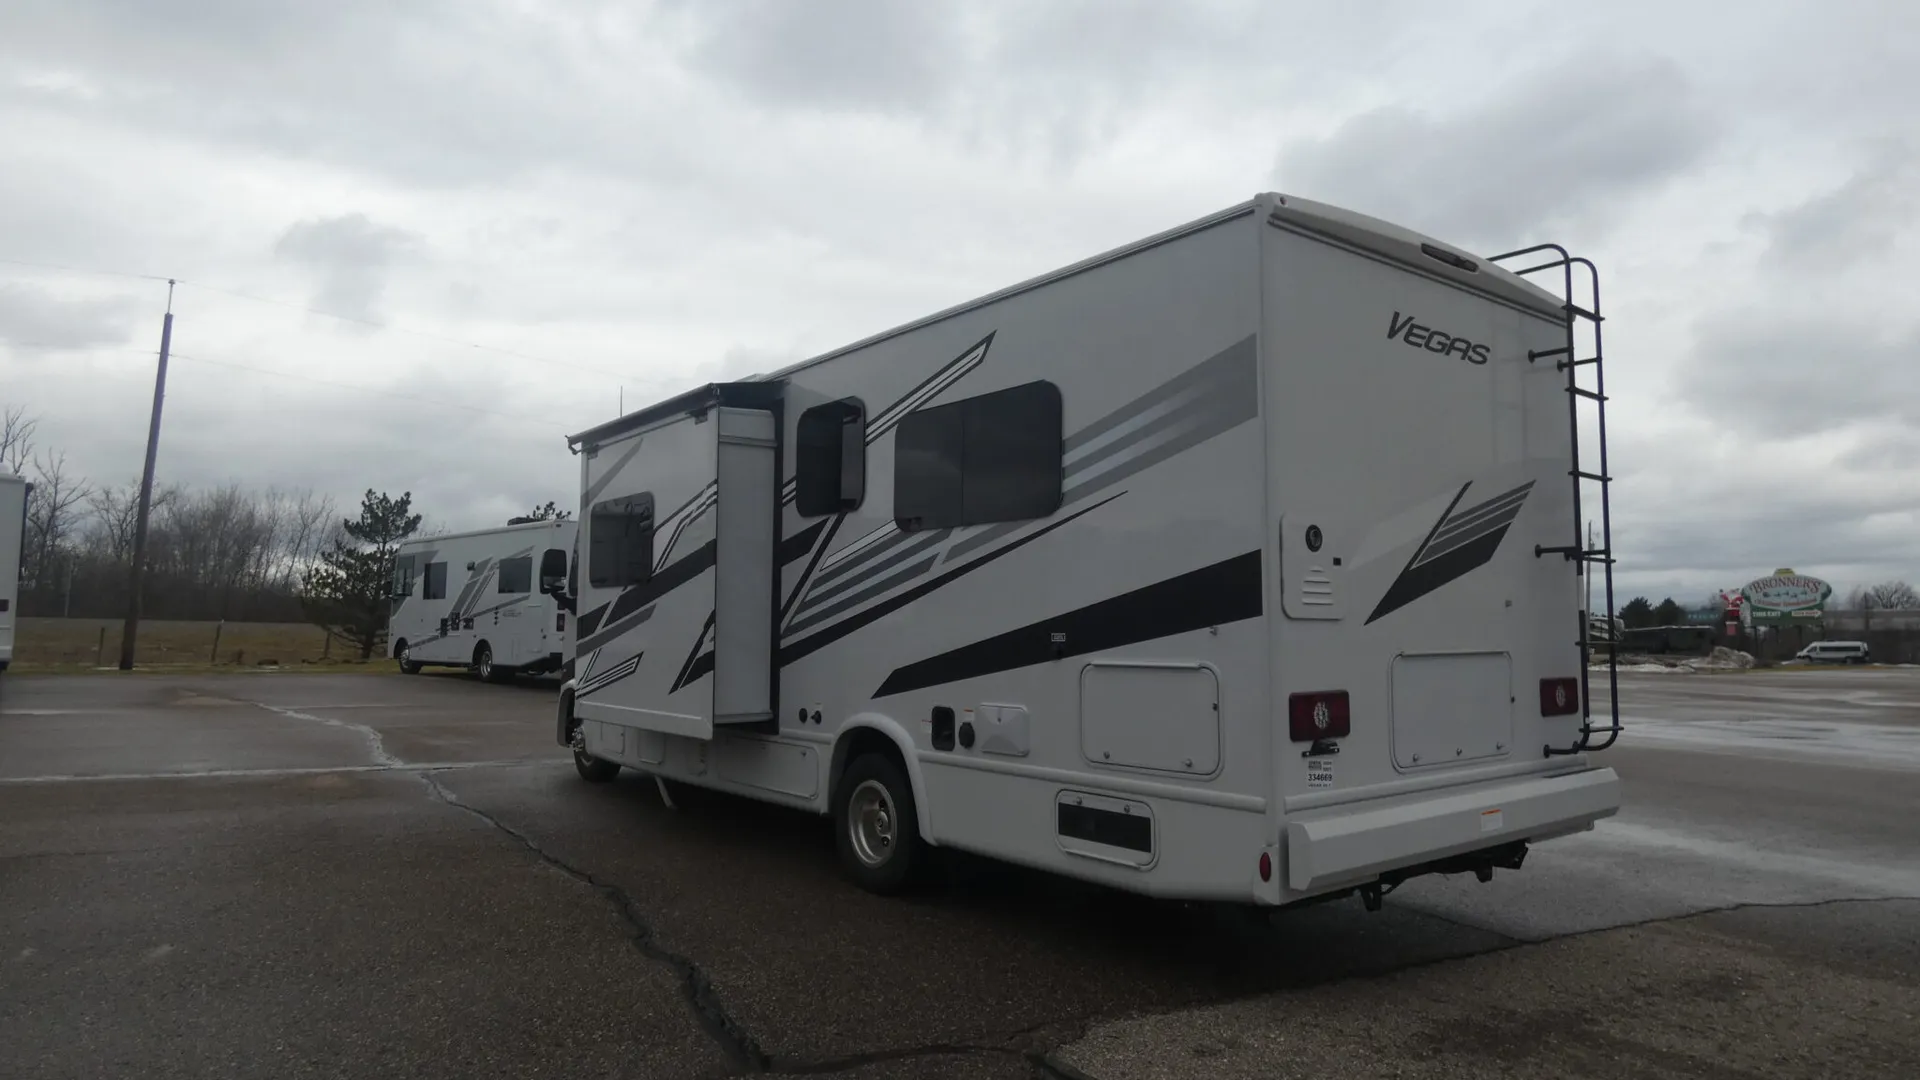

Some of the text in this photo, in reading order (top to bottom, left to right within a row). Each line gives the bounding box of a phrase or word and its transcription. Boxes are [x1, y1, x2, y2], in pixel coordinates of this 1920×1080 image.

[1387, 310, 1491, 365] VEGAS
[1750, 577, 1821, 594] BRONNER'S
[1308, 773, 1333, 782] 334669
